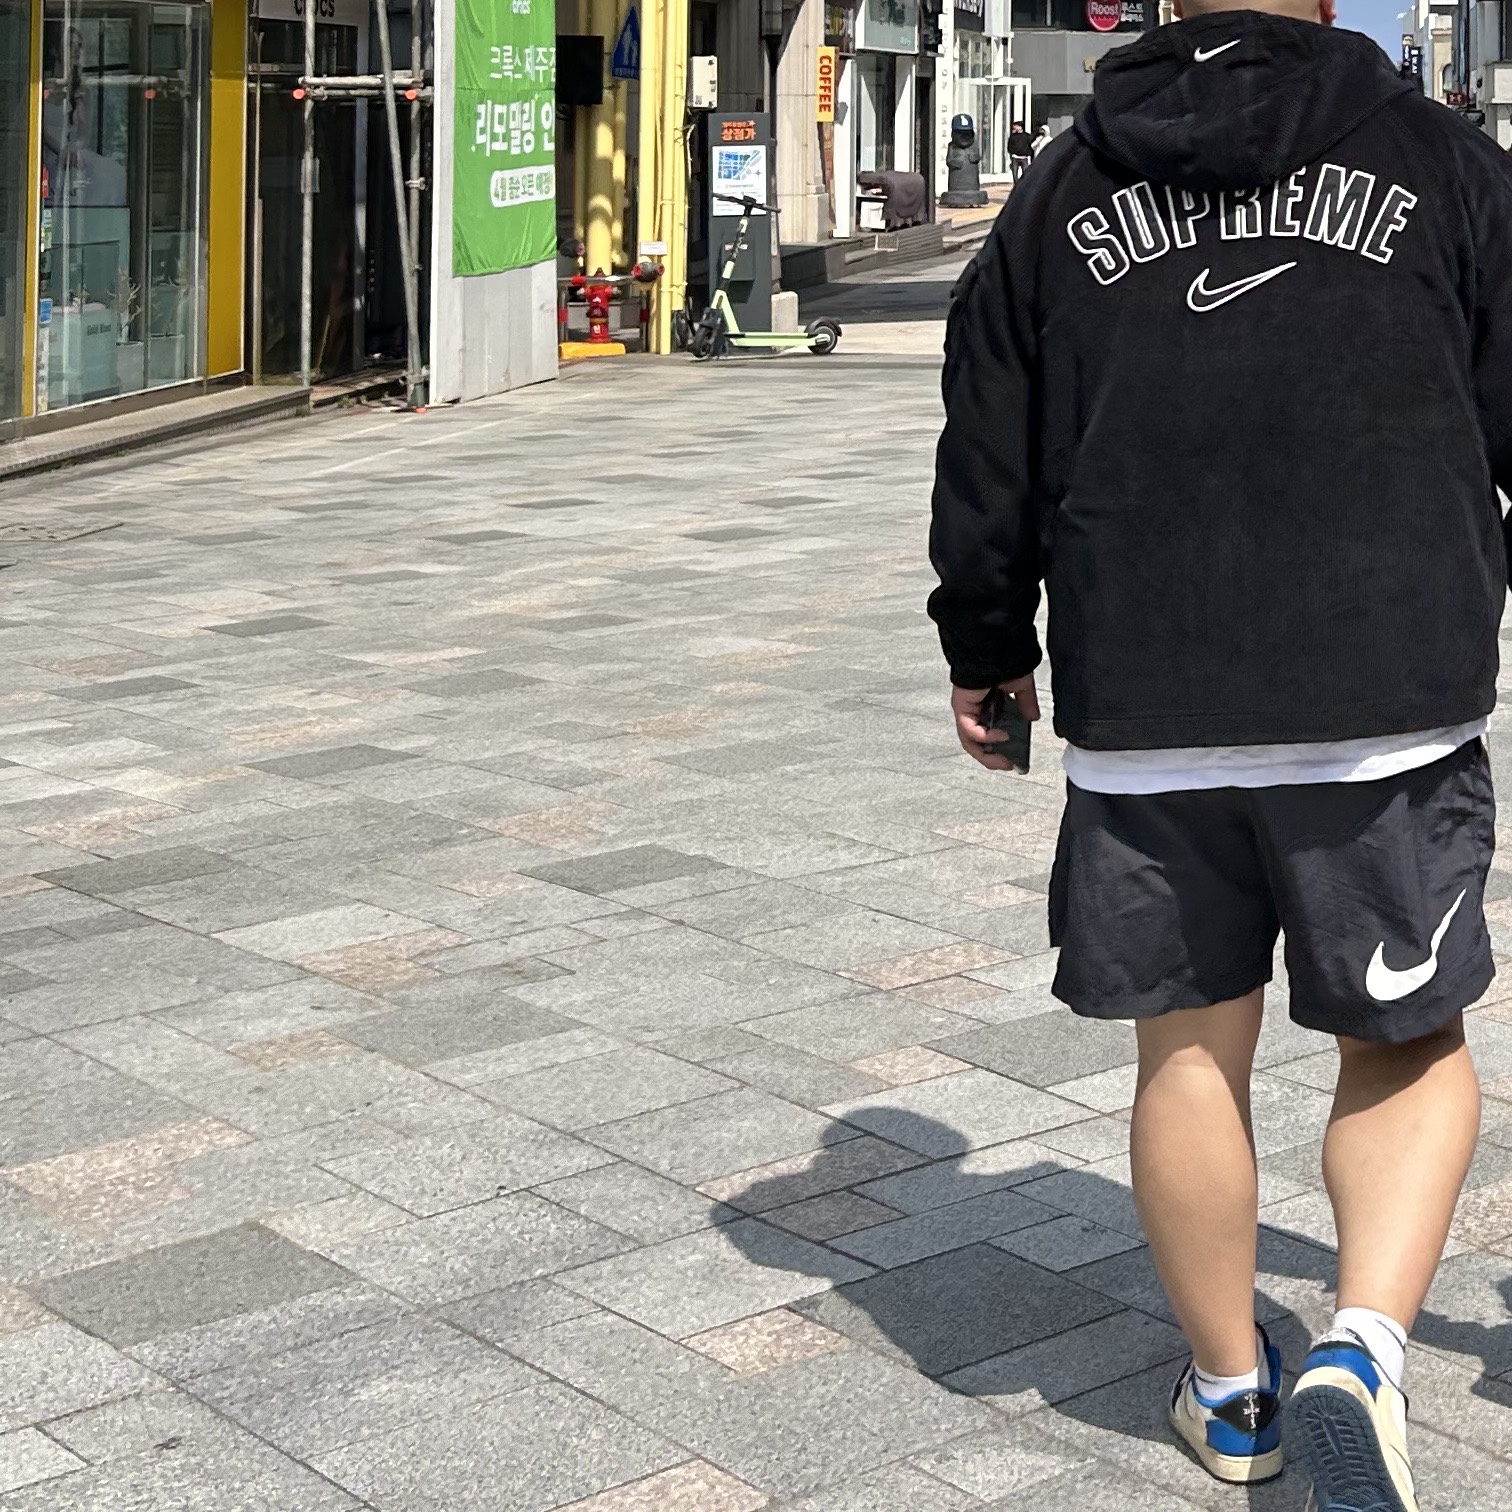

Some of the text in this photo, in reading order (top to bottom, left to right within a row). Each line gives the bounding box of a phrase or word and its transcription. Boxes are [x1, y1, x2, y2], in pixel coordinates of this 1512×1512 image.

[1090, 1, 1119, 15] Roost
[818, 54, 833, 113] COFFEE
[475, 97, 536, 157] 리모델링
[722, 128, 756, 141] 상점가
[1067, 163, 1418, 286] SUPREME
